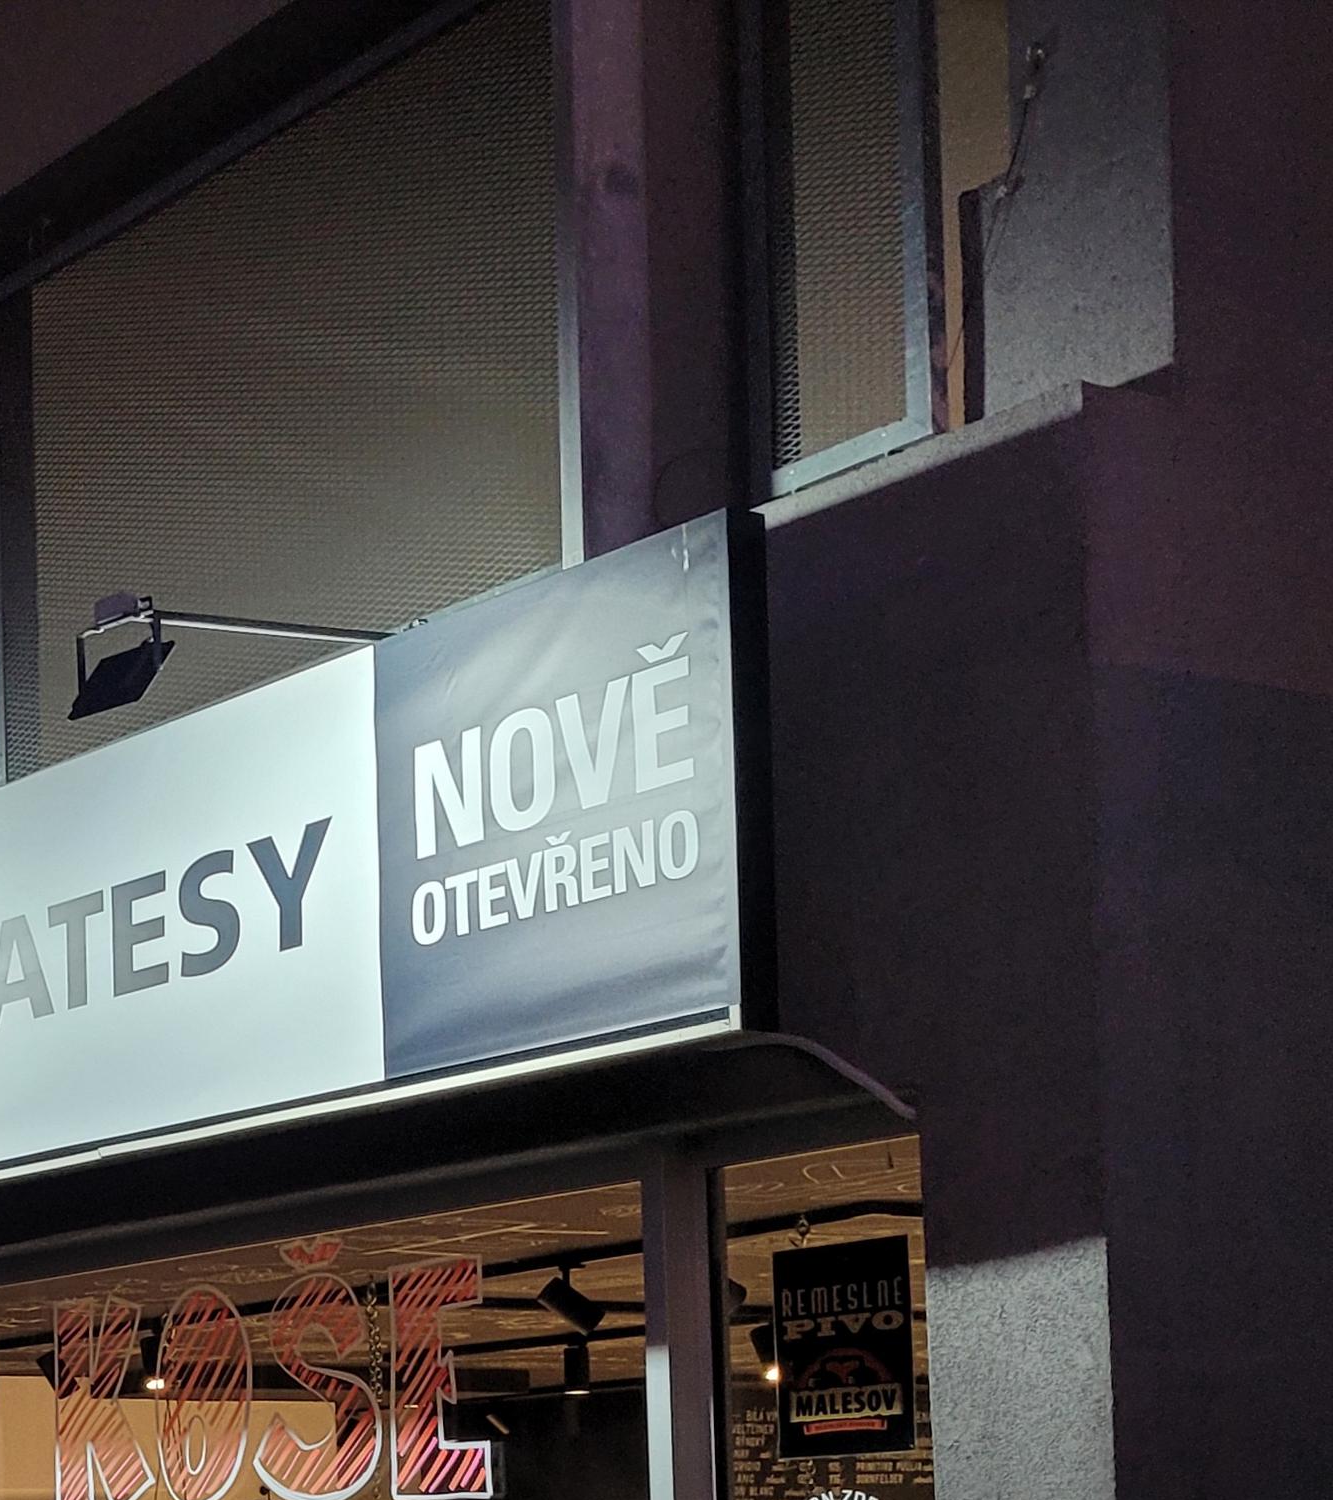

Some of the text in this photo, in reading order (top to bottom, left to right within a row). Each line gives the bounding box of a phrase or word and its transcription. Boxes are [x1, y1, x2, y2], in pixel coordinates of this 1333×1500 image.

[414, 631, 695, 860] NOVĚ
[411, 810, 700, 946] OTEVŘENO
[782, 1309, 905, 1341] PIVO
